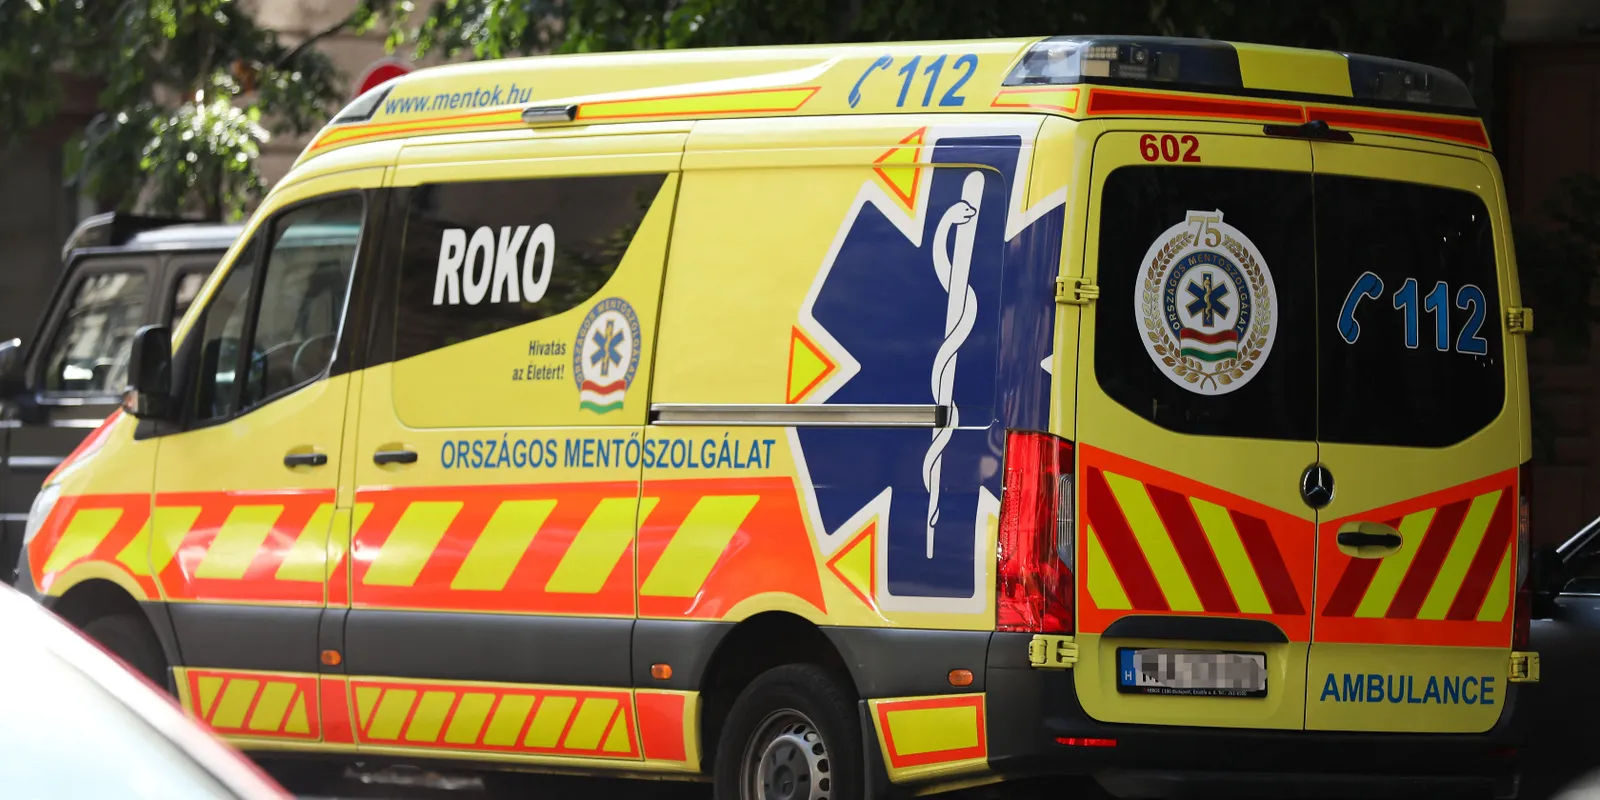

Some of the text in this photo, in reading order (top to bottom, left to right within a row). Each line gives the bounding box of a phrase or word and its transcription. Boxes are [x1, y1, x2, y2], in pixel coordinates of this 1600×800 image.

[896, 53, 979, 107] 112
[385, 83, 533, 115] www.mentok.hu
[1140, 134, 1201, 163] 602
[1189, 215, 1222, 248] 75
[433, 223, 555, 305] ROKO
[1393, 277, 1488, 356] 112
[528, 338, 567, 356] Hivatás
[512, 360, 565, 380] az Életért!
[440, 431, 776, 469] ORSZÁGOS MENTŐSZOLGÁLAT
[1124, 670, 1133, 681] H
[1319, 673, 1496, 705] AMBULANCE
